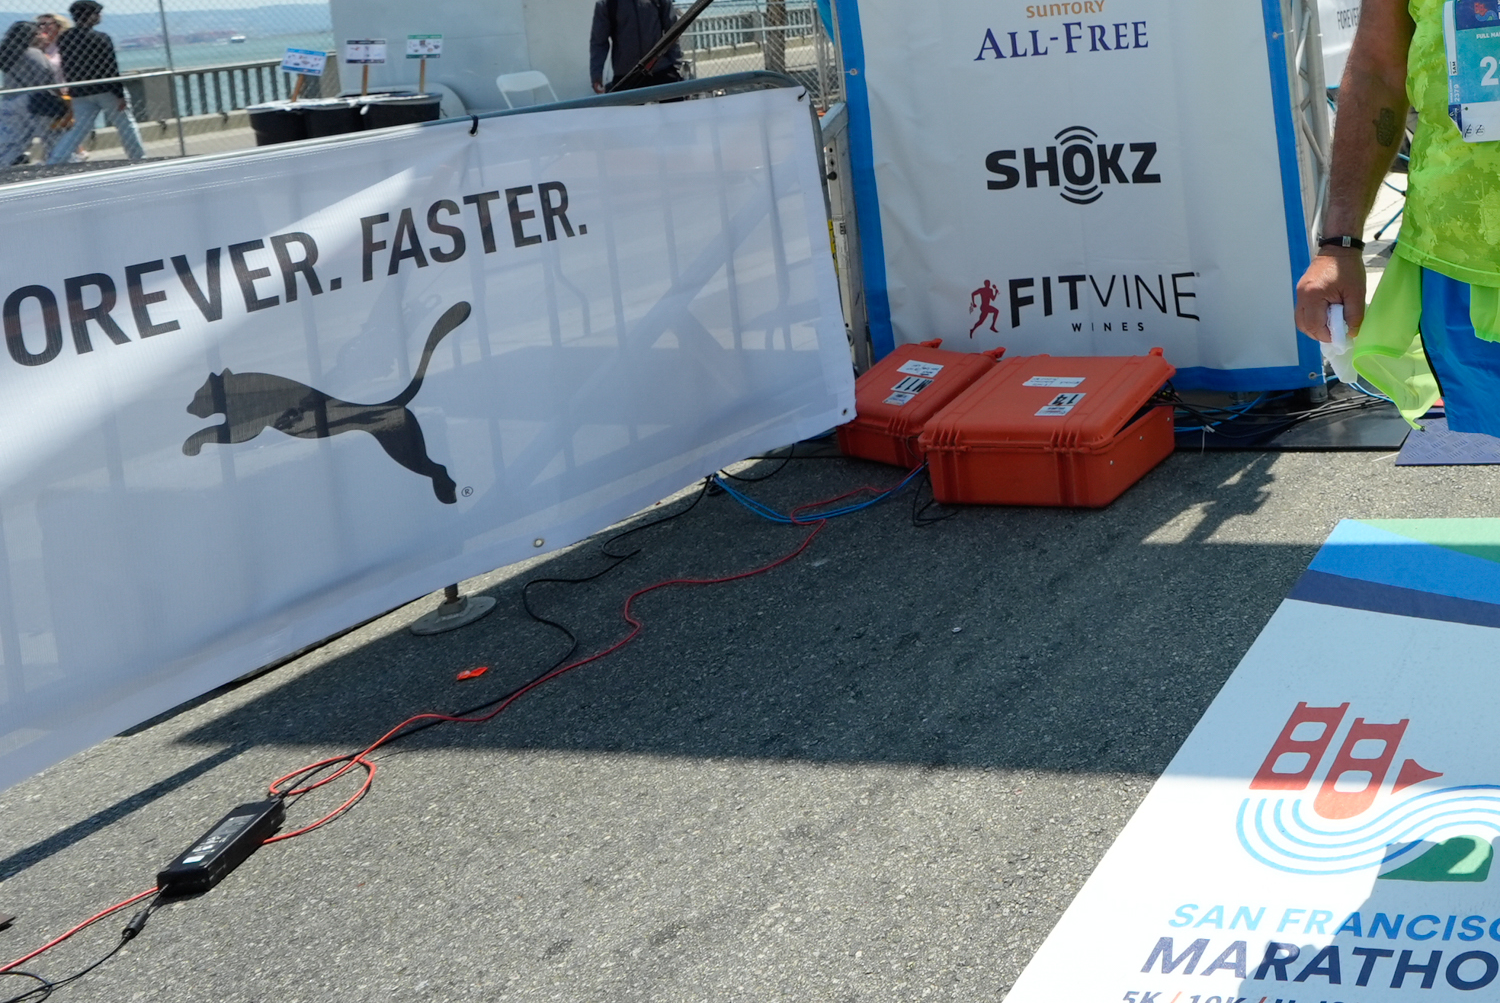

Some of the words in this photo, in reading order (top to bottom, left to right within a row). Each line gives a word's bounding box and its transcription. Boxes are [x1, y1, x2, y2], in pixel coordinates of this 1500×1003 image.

[973, 21, 1149, 61] ALL-FREE
[985, 142, 1161, 190] SHOKZ
[2, 231, 343, 367] OREVER.
[361, 180, 588, 282] FASTER.
[1008, 272, 1200, 328] FITVINE
[1072, 322, 1144, 332] WINES
[1168, 903, 1266, 931] SAN
